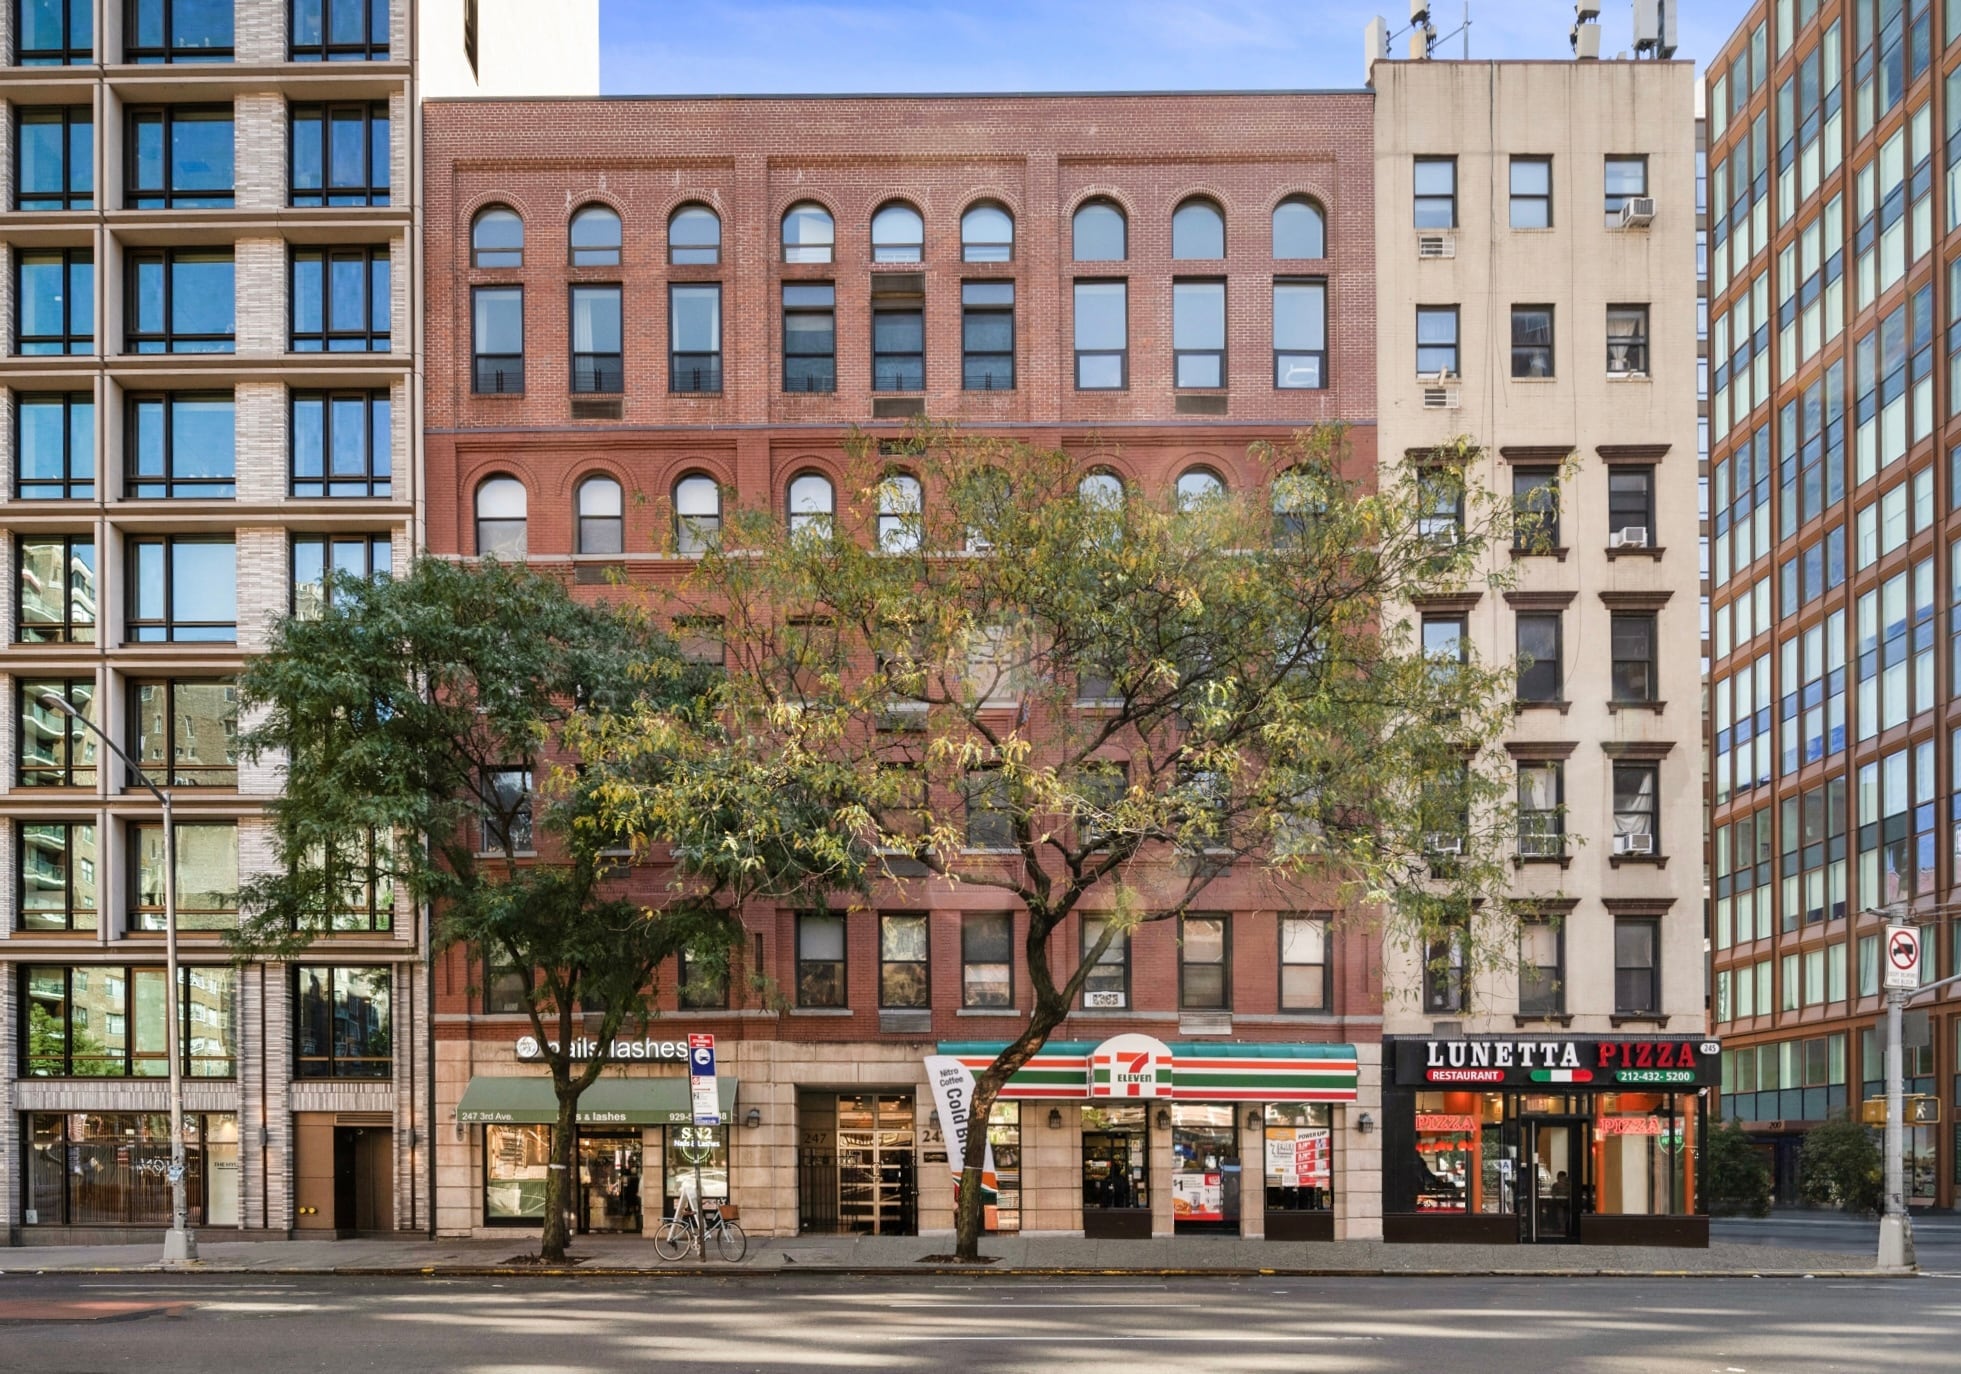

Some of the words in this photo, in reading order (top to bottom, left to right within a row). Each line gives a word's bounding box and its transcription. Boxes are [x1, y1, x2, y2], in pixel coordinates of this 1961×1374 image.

[611, 1037, 688, 1058] lashes
[1704, 1043, 1716, 1053] 245
[1426, 1042, 1580, 1067] LUNETTA
[1598, 1042, 1696, 1067] PIZZA
[940, 1068, 959, 1077] Nitro
[1432, 1071, 1499, 1081] RESTAURANT
[940, 1076, 964, 1087] Coffee
[946, 1088, 968, 1125] Cold
[462, 1112, 478, 1121] 247
[480, 1112, 494, 1121] 3rd
[495, 1112, 514, 1121] Ave.
[593, 1112, 627, 1121] lashes
[1415, 1115, 1477, 1131] PIZZA
[1600, 1116, 1662, 1134] PIZZA
[804, 1133, 827, 1144] 247
